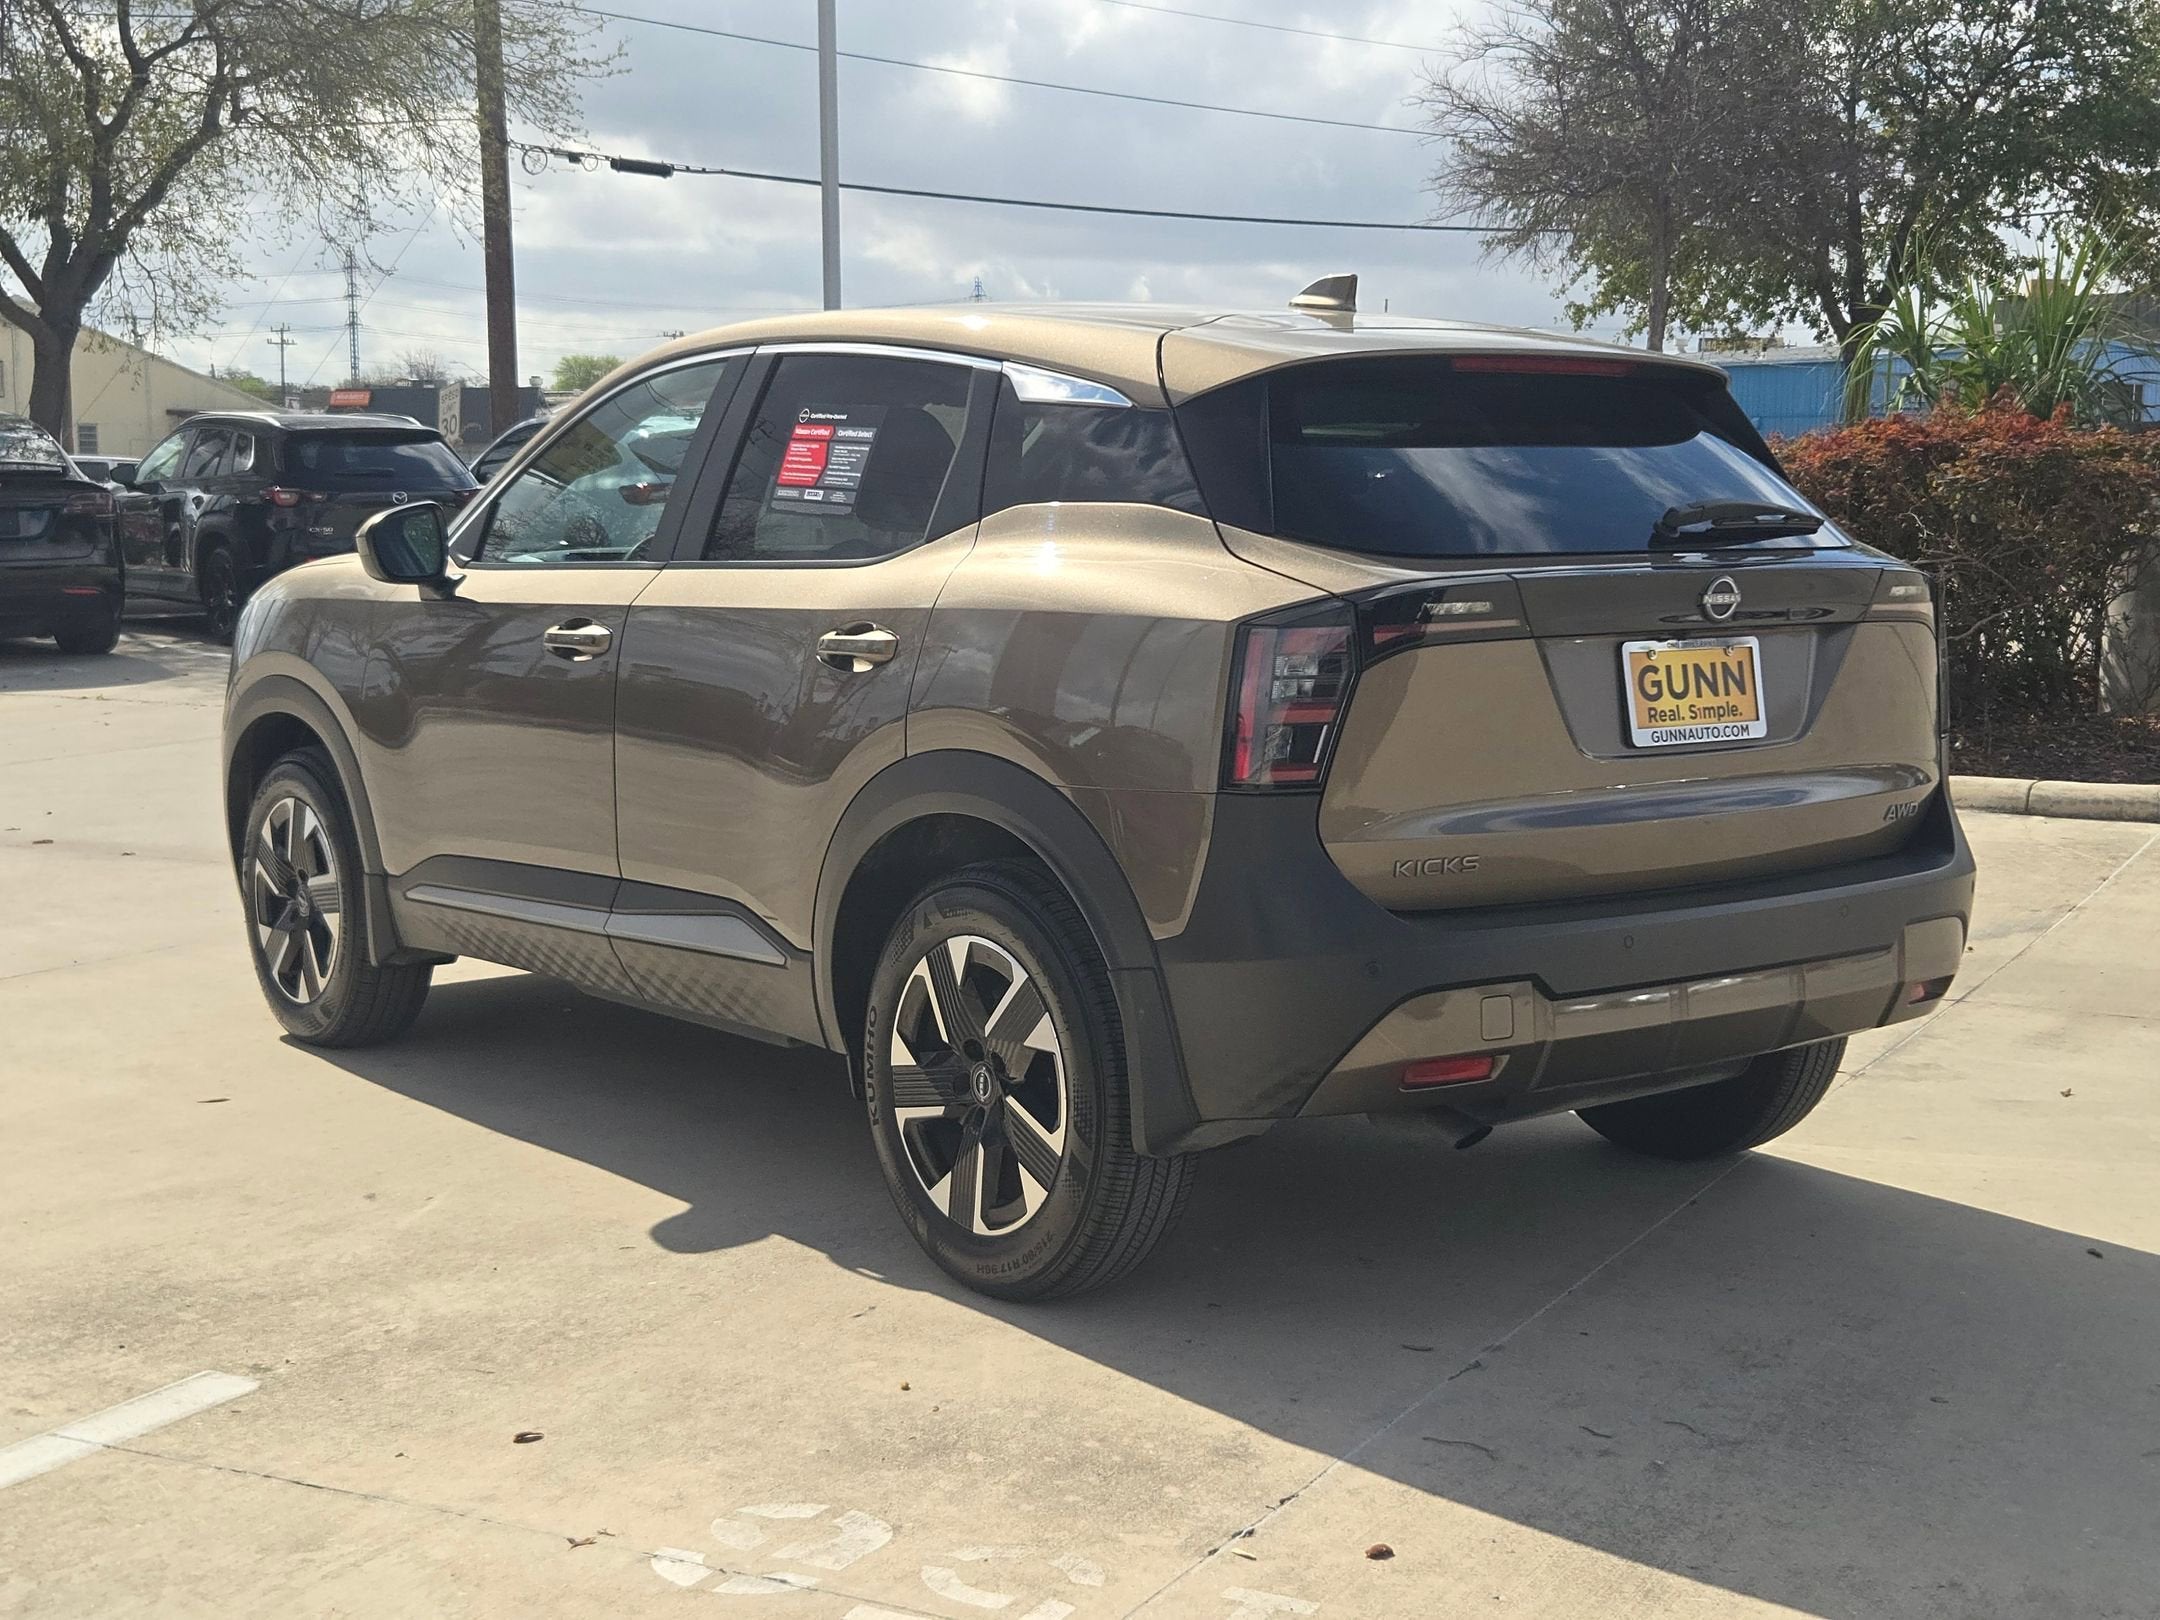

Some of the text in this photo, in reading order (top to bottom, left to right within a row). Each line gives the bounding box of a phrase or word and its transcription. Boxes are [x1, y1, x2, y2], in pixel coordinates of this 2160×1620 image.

[441, 414, 458, 437] 30
[837, 430, 857, 438] Certified
[1703, 592, 1741, 605] NISSAN
[1638, 661, 1747, 702] GUNN
[1647, 704, 1685, 723] Real.
[1651, 724, 1750, 743] GUNNAUTO.COM
[1883, 802, 1919, 821] AWD
[1394, 855, 1480, 878] KICKS
[866, 1005, 880, 1126] KUMHO
